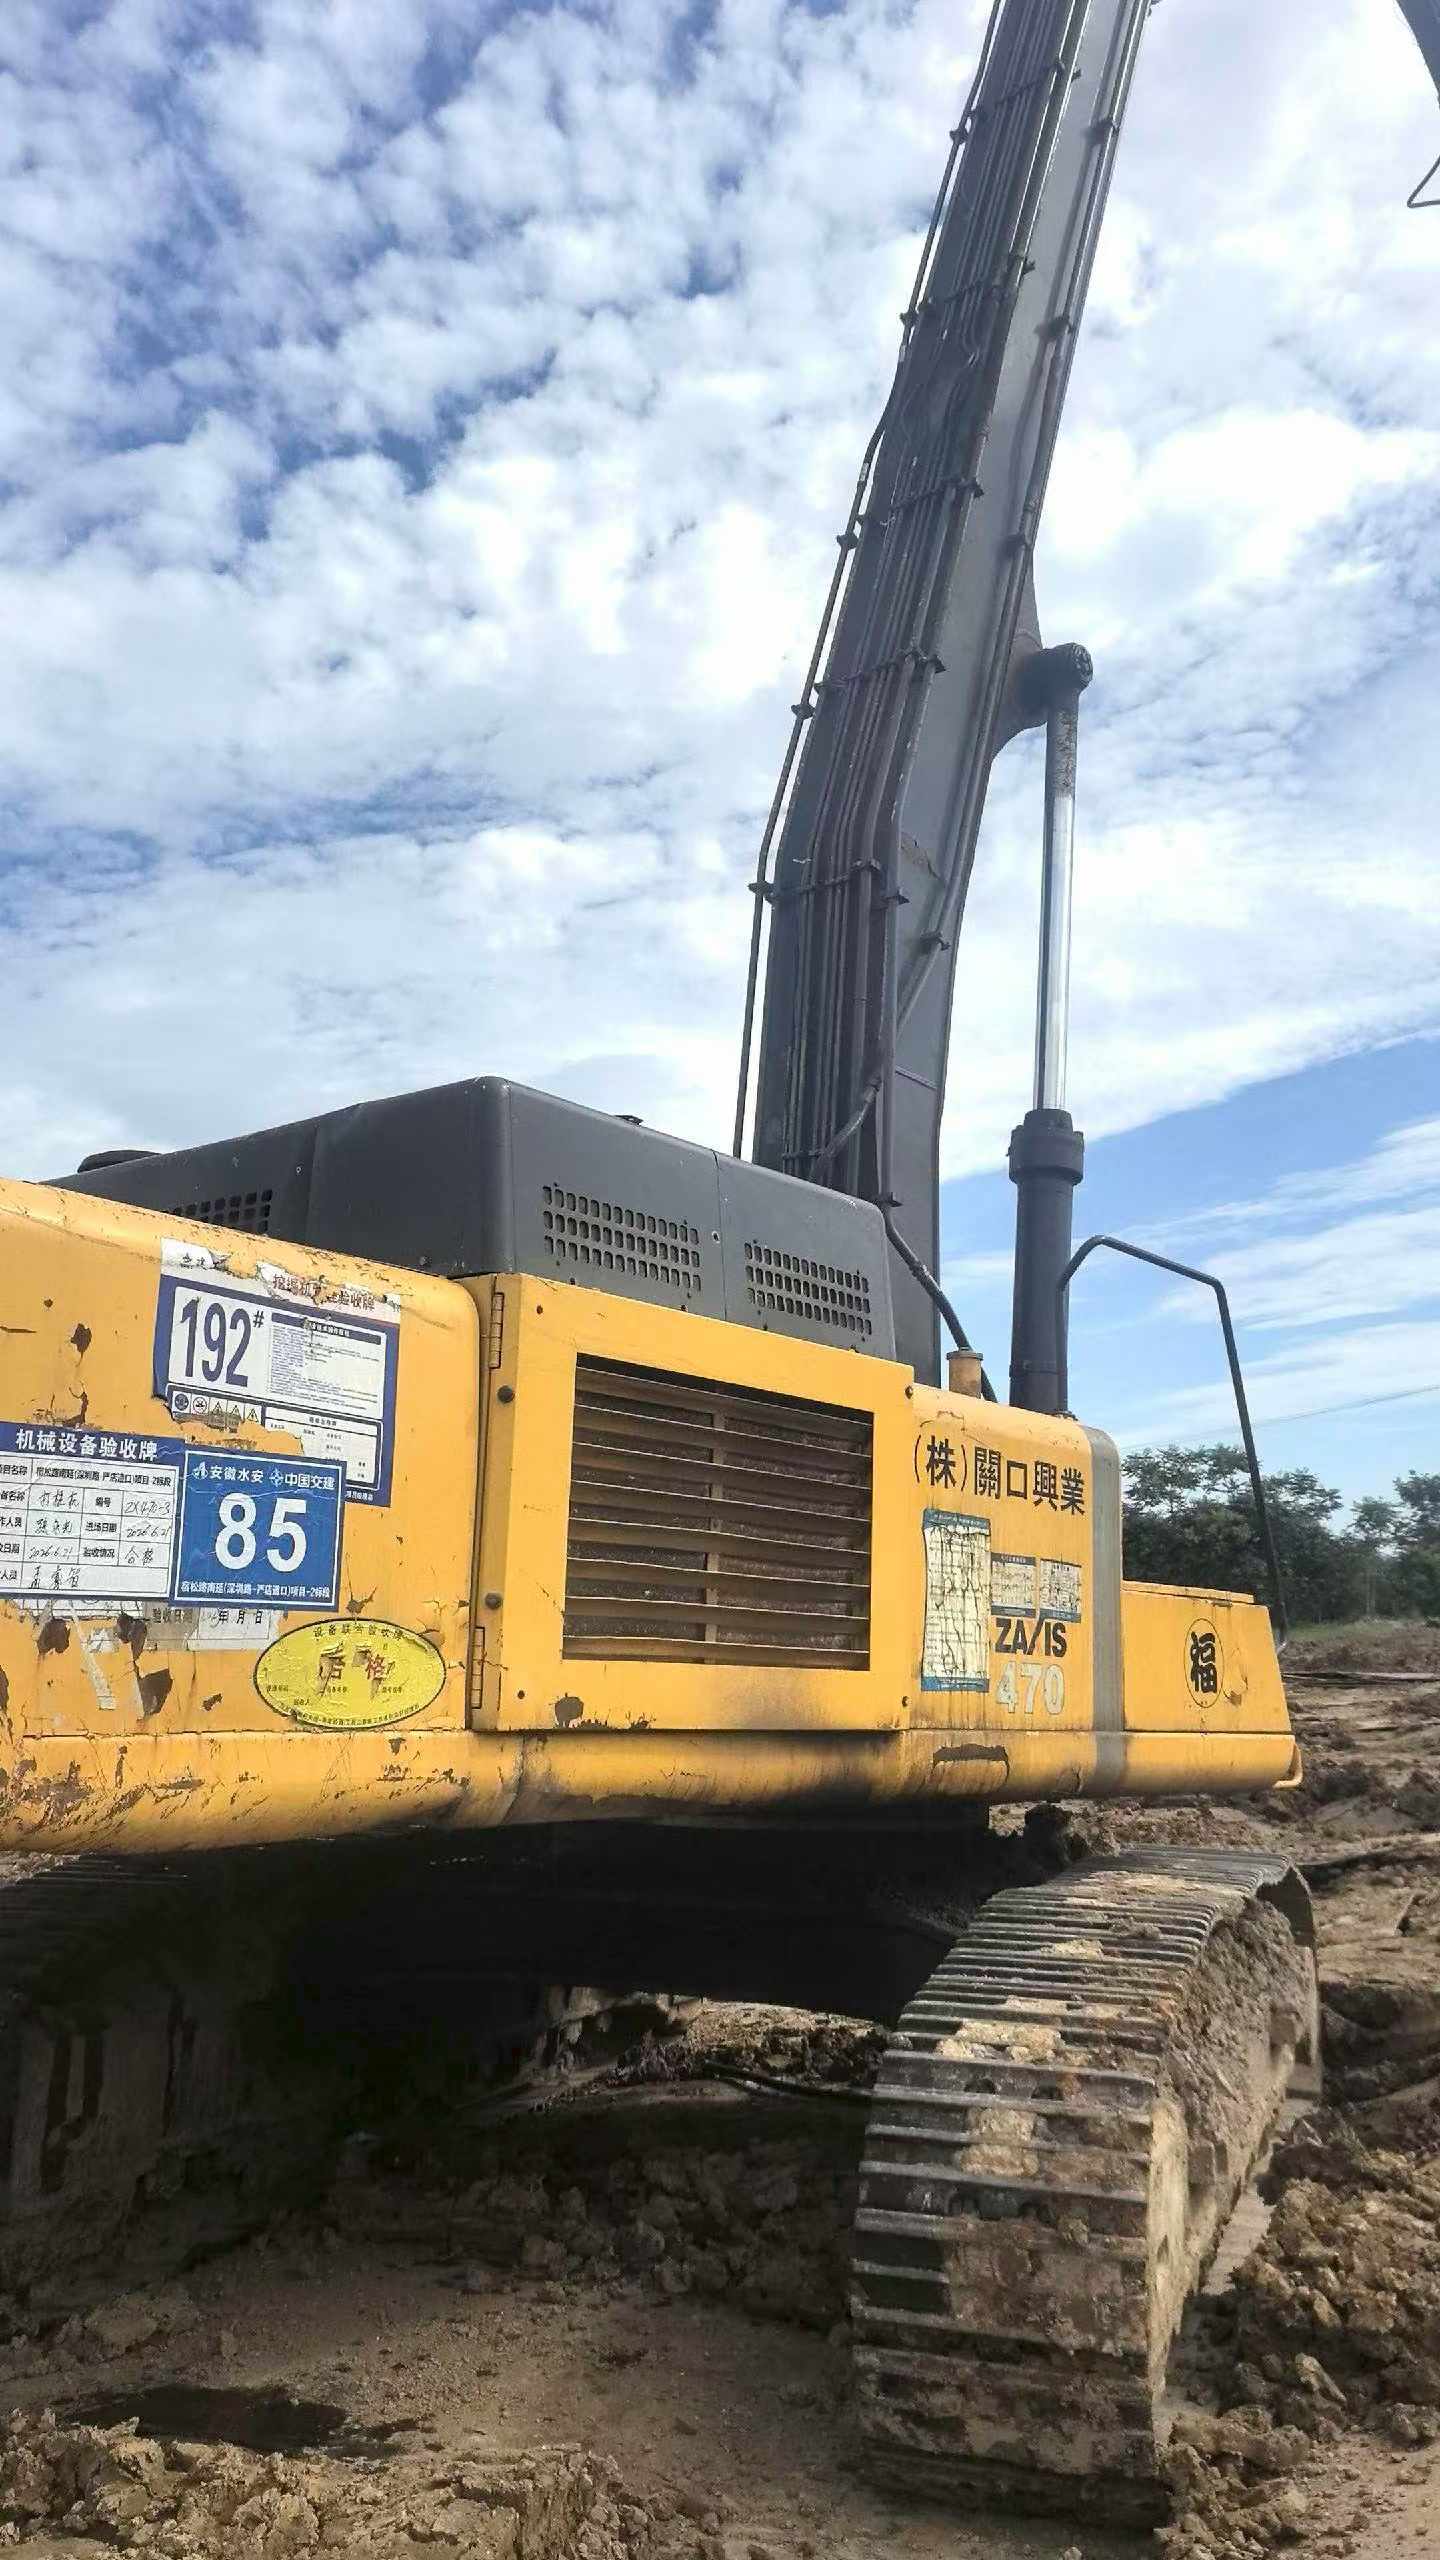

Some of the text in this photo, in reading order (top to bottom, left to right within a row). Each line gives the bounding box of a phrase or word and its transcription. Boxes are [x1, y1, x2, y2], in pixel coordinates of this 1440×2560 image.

[16, 1428, 158, 1462] 机械设备验收牌
[209, 1464, 264, 1484] 安徽水安
[284, 1472, 336, 1491] 中国交建
[0, 1489, 25, 1502] 备名称
[215, 1492, 307, 1573] 85
[1190, 1631, 1218, 1693] 福
[996, 1660, 1066, 1715] 470
